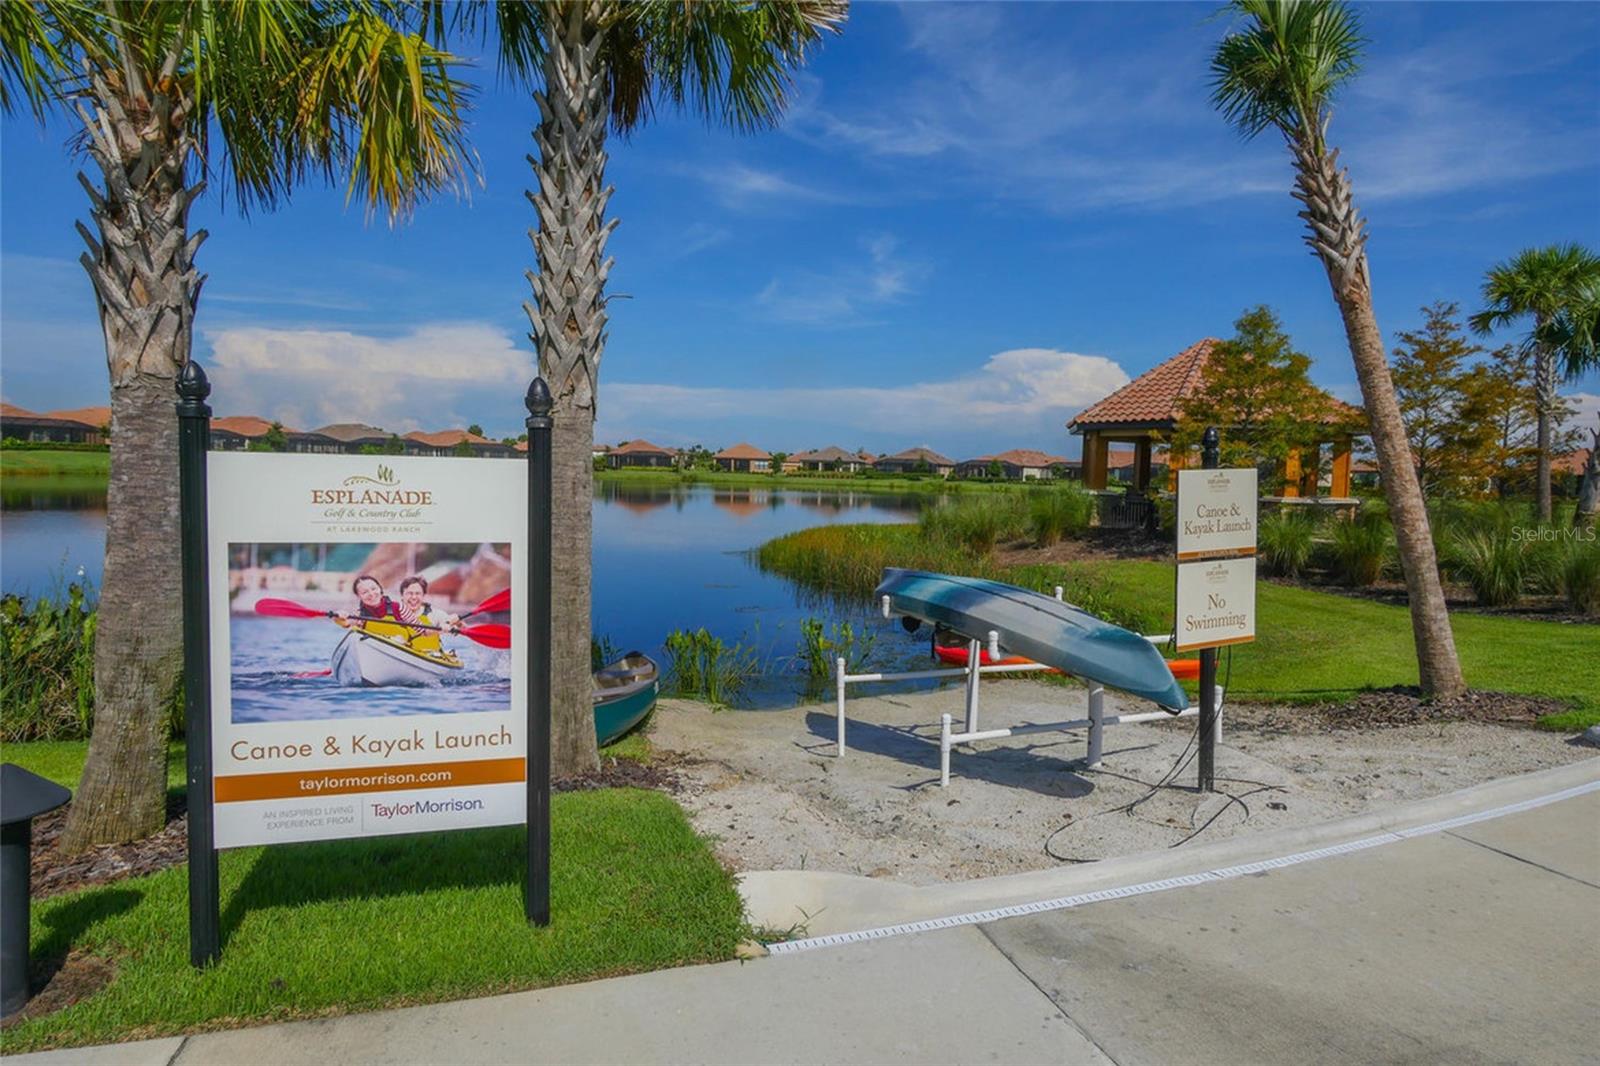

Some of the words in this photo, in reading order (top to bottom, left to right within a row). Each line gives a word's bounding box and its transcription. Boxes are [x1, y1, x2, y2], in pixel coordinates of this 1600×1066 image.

[311, 489, 432, 505] ESPLANADE
[324, 508, 345, 520] Golf
[347, 508, 356, 518] &
[359, 508, 397, 521] Country
[399, 508, 421, 518] Club
[1196, 503, 1228, 518] Canoe
[1230, 501, 1242, 517] &
[1184, 519, 1215, 539] Kayak
[1216, 517, 1252, 533] Launch
[1208, 592, 1227, 611] No
[1185, 611, 1247, 632] Swimming
[230, 740, 313, 762] Canoe
[323, 735, 341, 756] &
[351, 728, 425, 758] Kayak
[435, 724, 513, 749] Launch
[299, 769, 452, 791] taylormorrison.com
